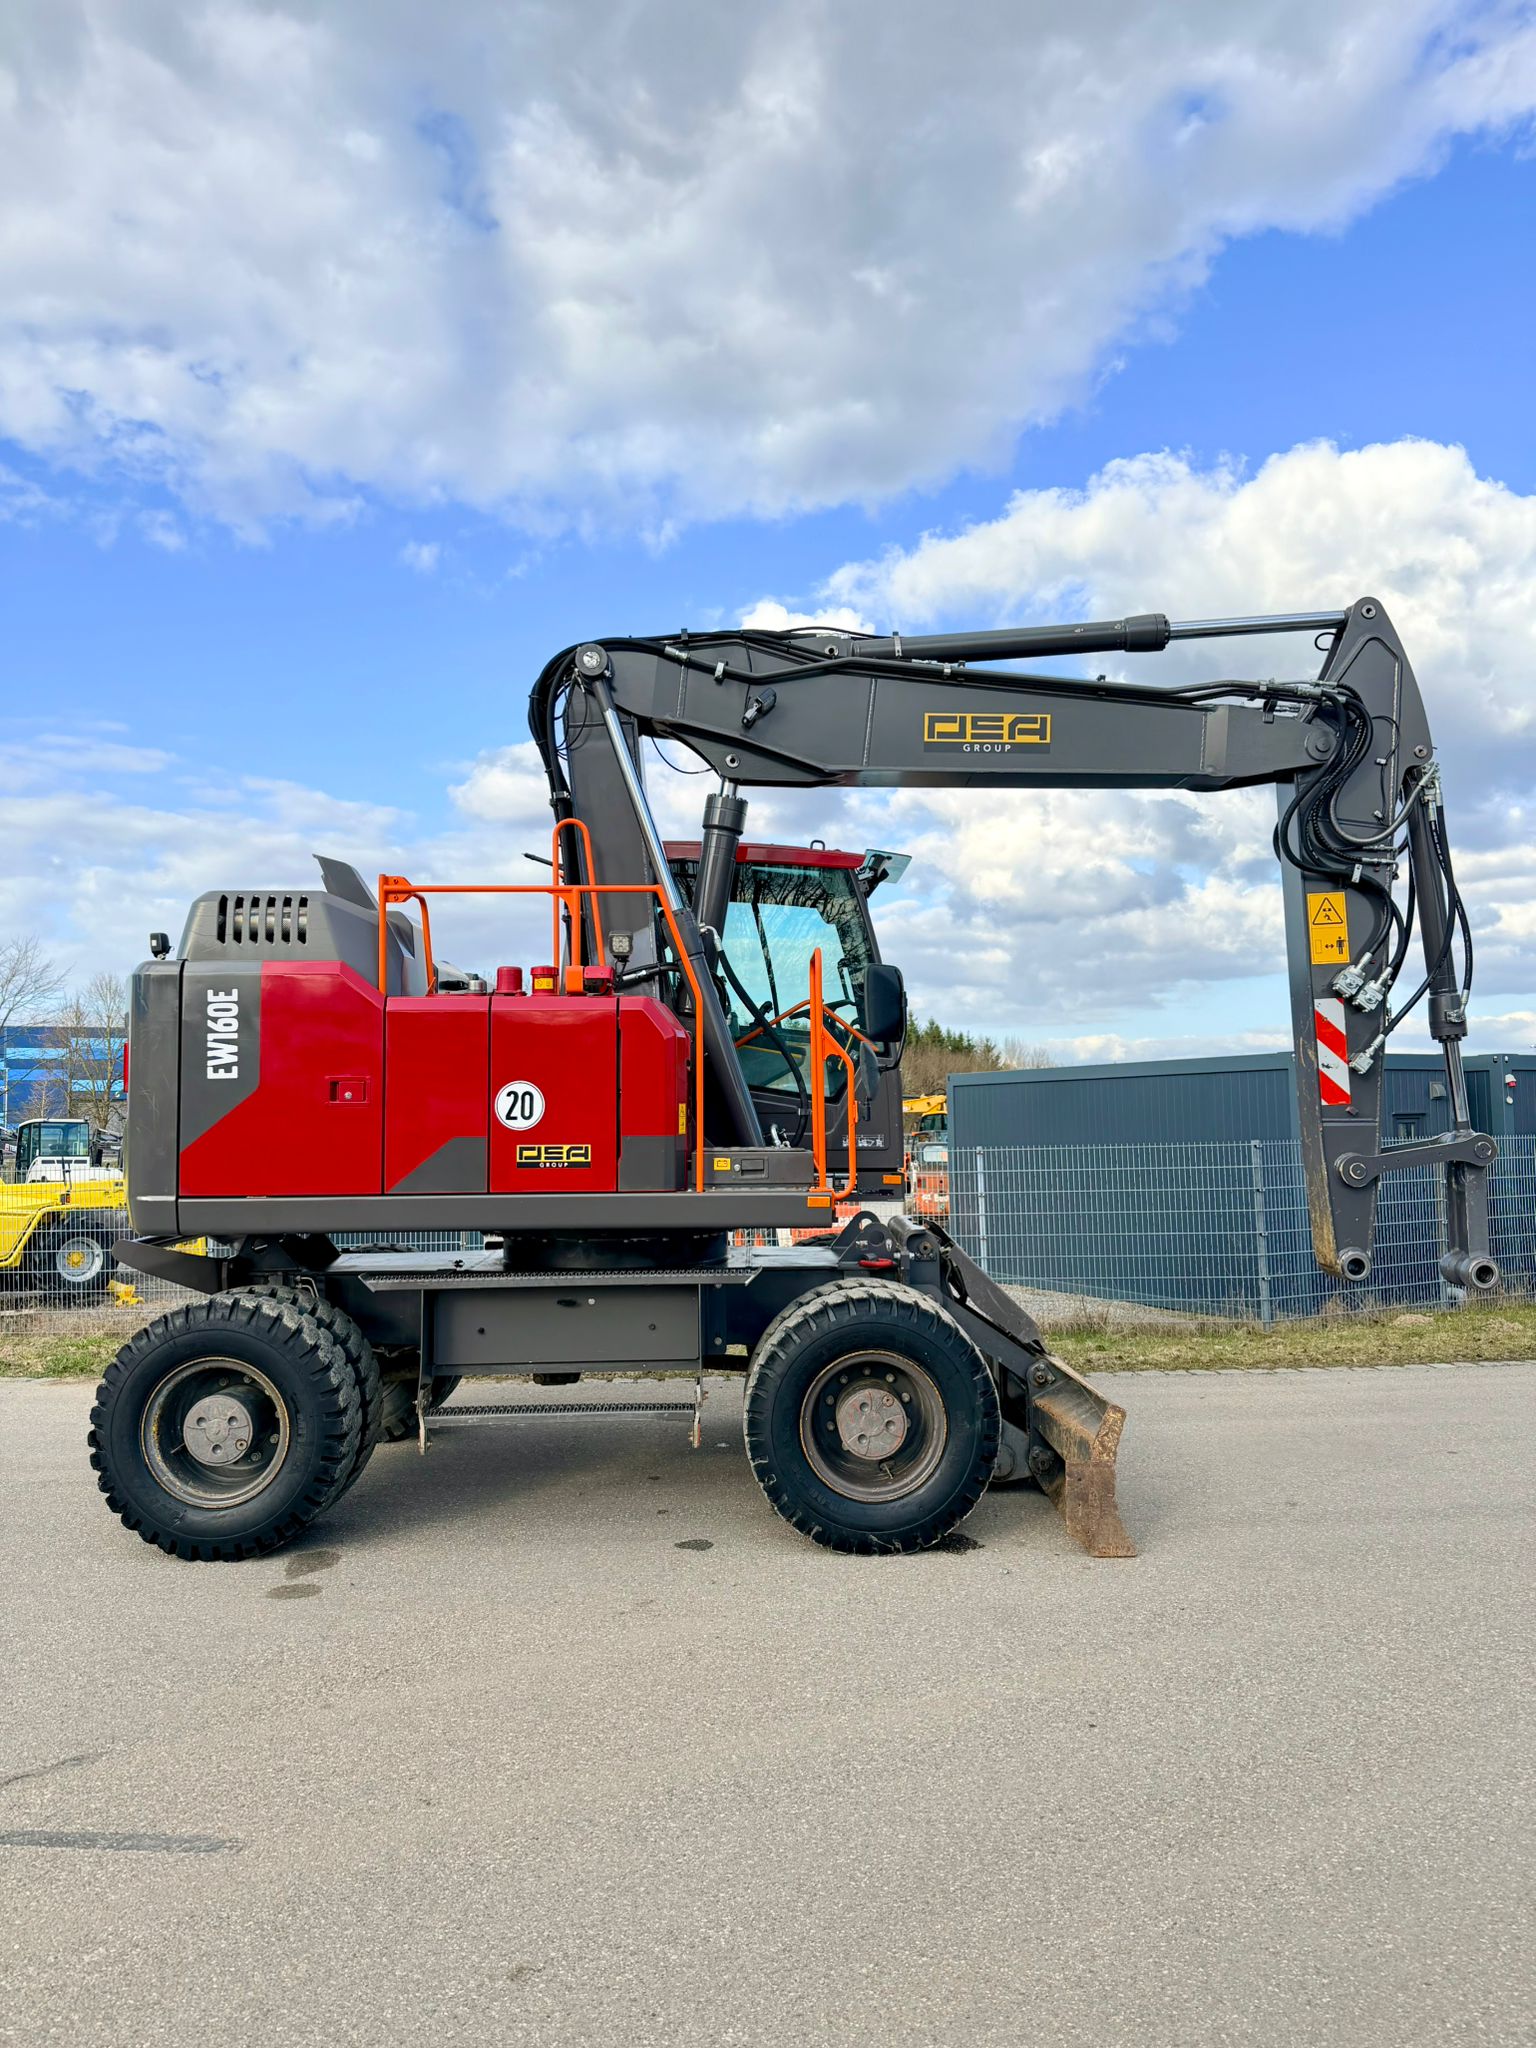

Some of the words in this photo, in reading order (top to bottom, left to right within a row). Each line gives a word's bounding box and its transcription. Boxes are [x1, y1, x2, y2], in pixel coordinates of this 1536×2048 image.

[962, 743, 1012, 753] GROUP
[206, 987, 240, 1080] EW160E
[505, 1090, 535, 1121] 20
